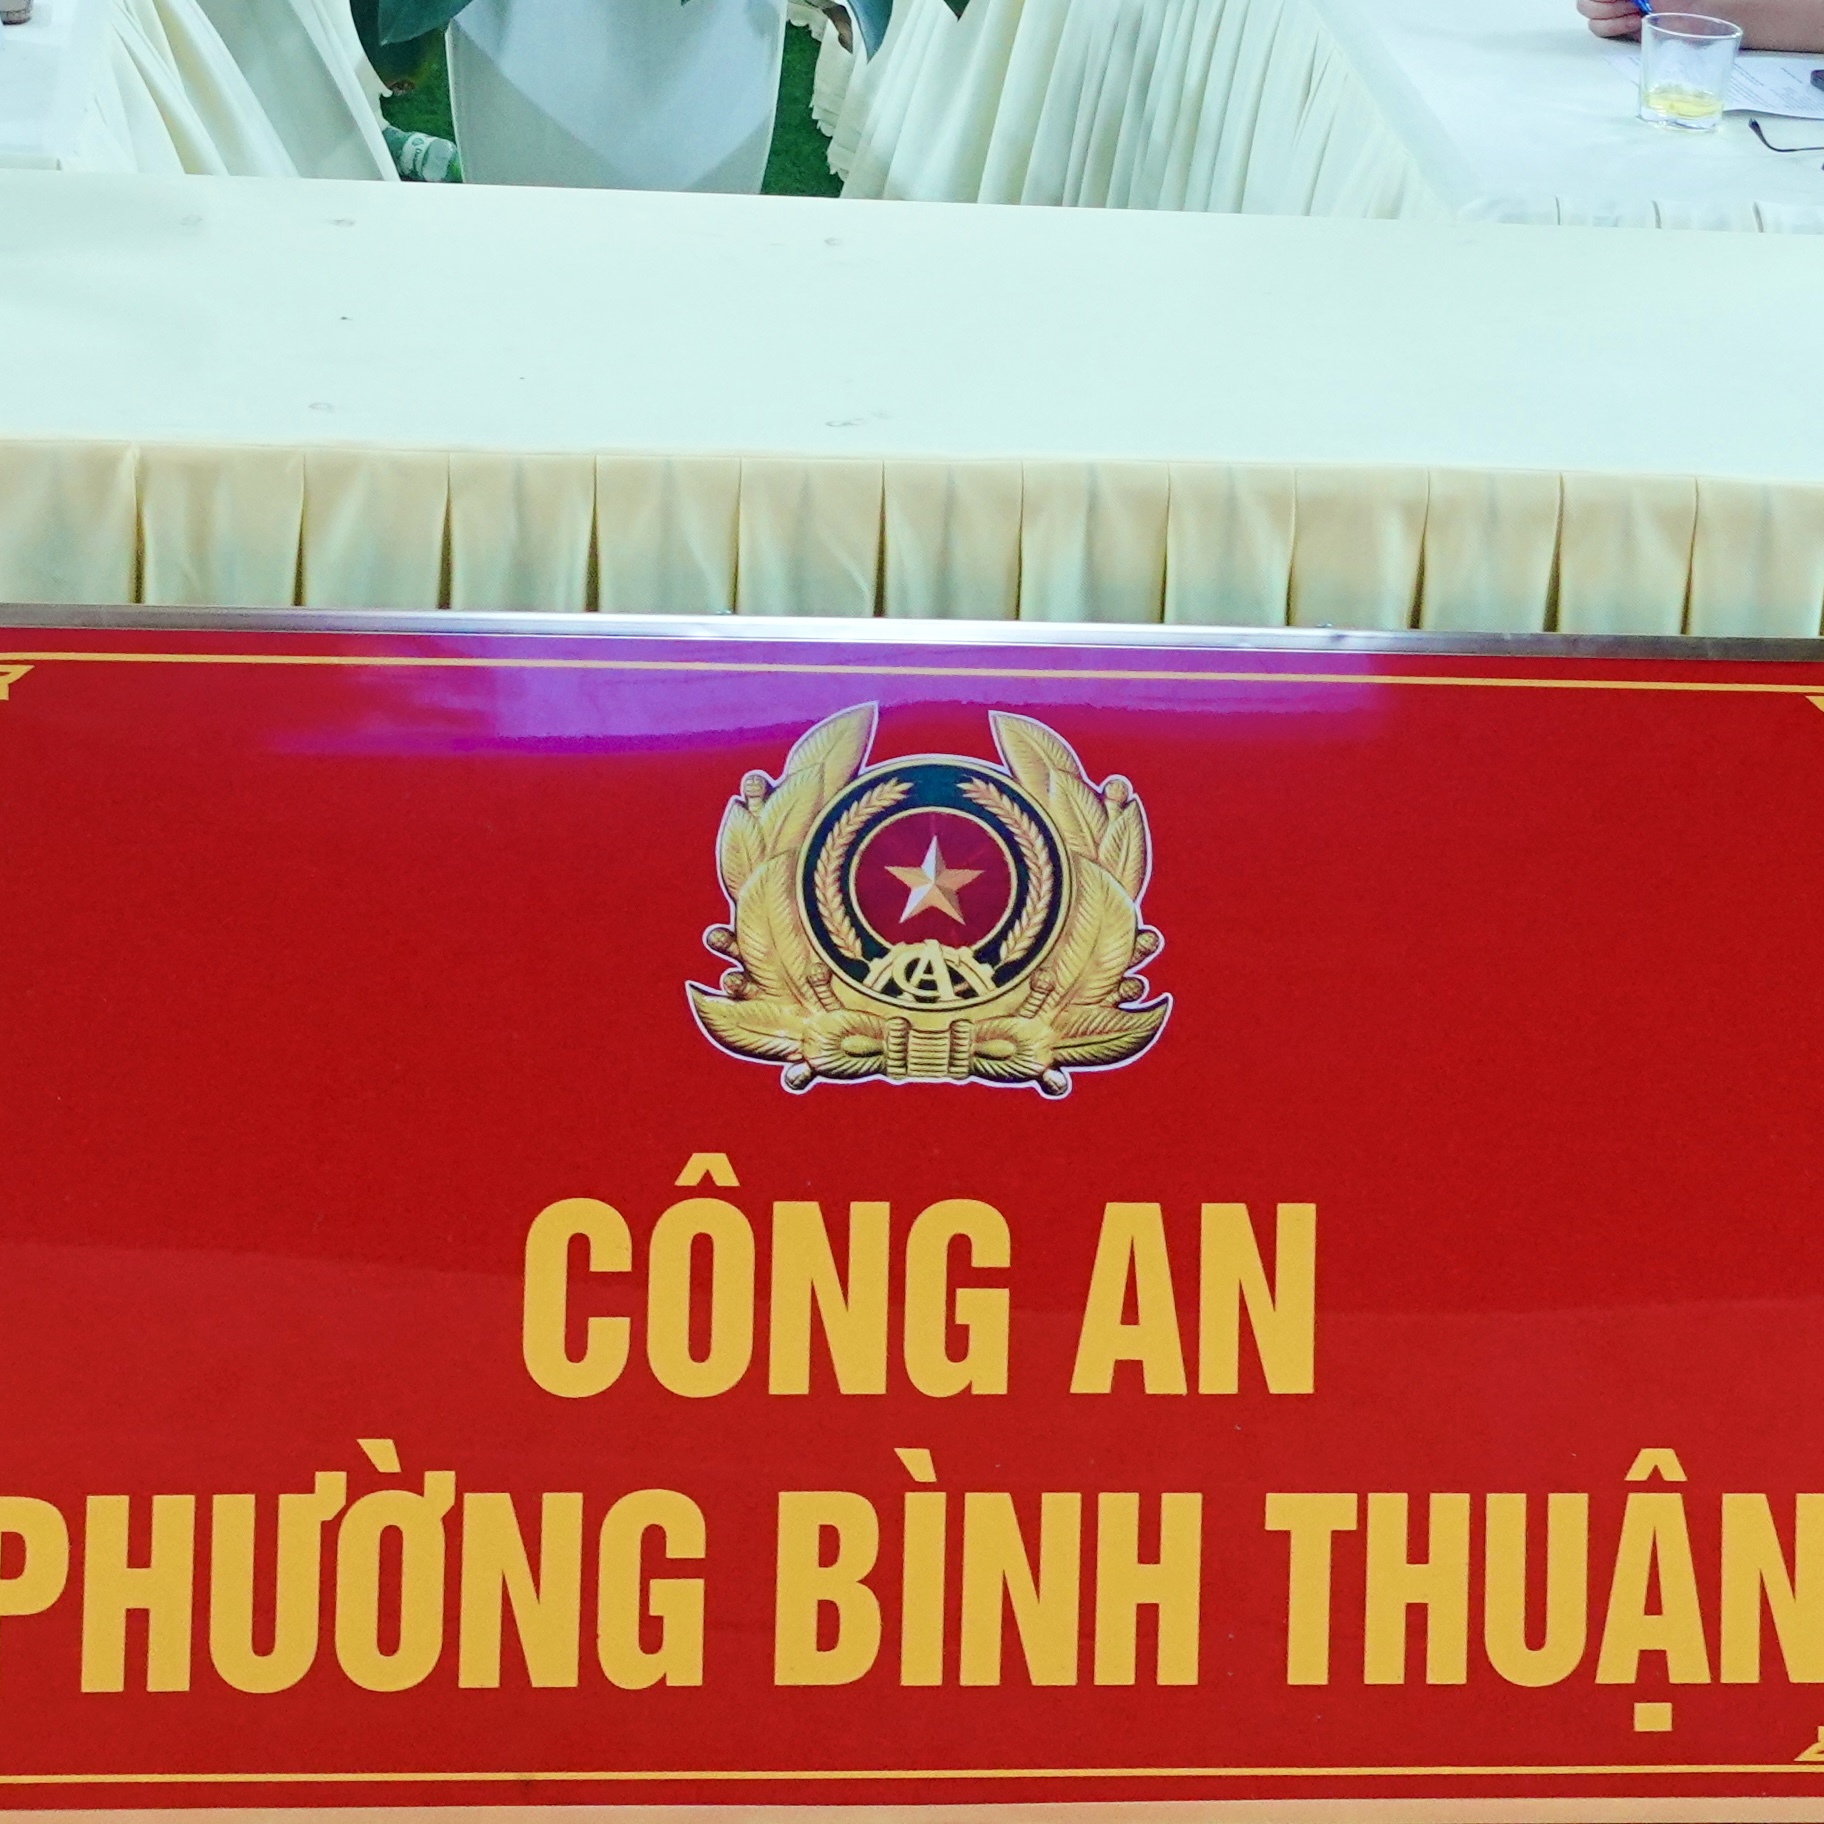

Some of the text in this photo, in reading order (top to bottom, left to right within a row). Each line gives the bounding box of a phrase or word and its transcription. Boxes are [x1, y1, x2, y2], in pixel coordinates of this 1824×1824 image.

[522, 1152, 1317, 1398] CÔNG AN
[774, 1448, 1203, 1687] BÌNH
